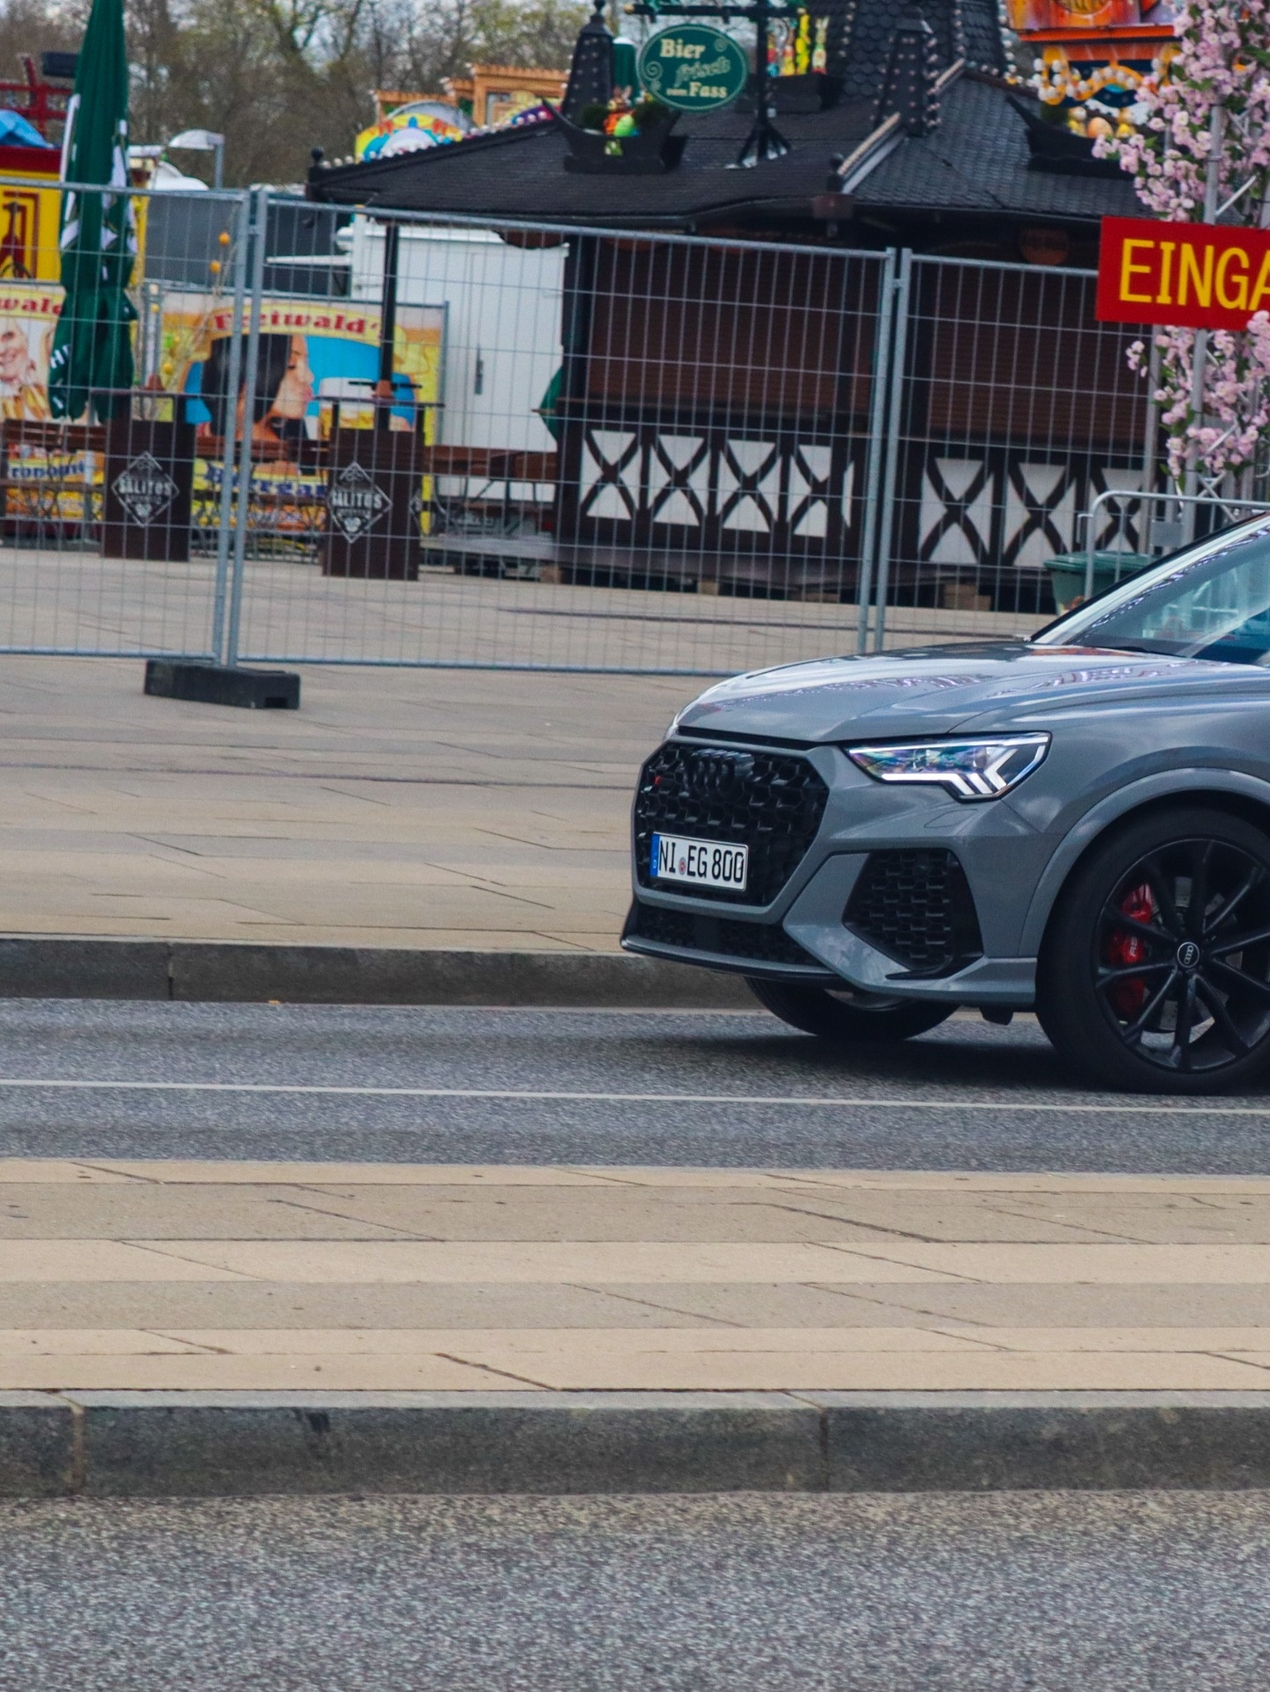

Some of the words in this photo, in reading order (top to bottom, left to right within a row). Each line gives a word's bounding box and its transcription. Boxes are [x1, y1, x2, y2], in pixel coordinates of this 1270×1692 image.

[660, 38, 707, 58] Bier
[688, 81, 728, 99] Fass
[658, 840, 677, 873] NI
[686, 845, 708, 878] EG
[711, 848, 745, 884] 800
